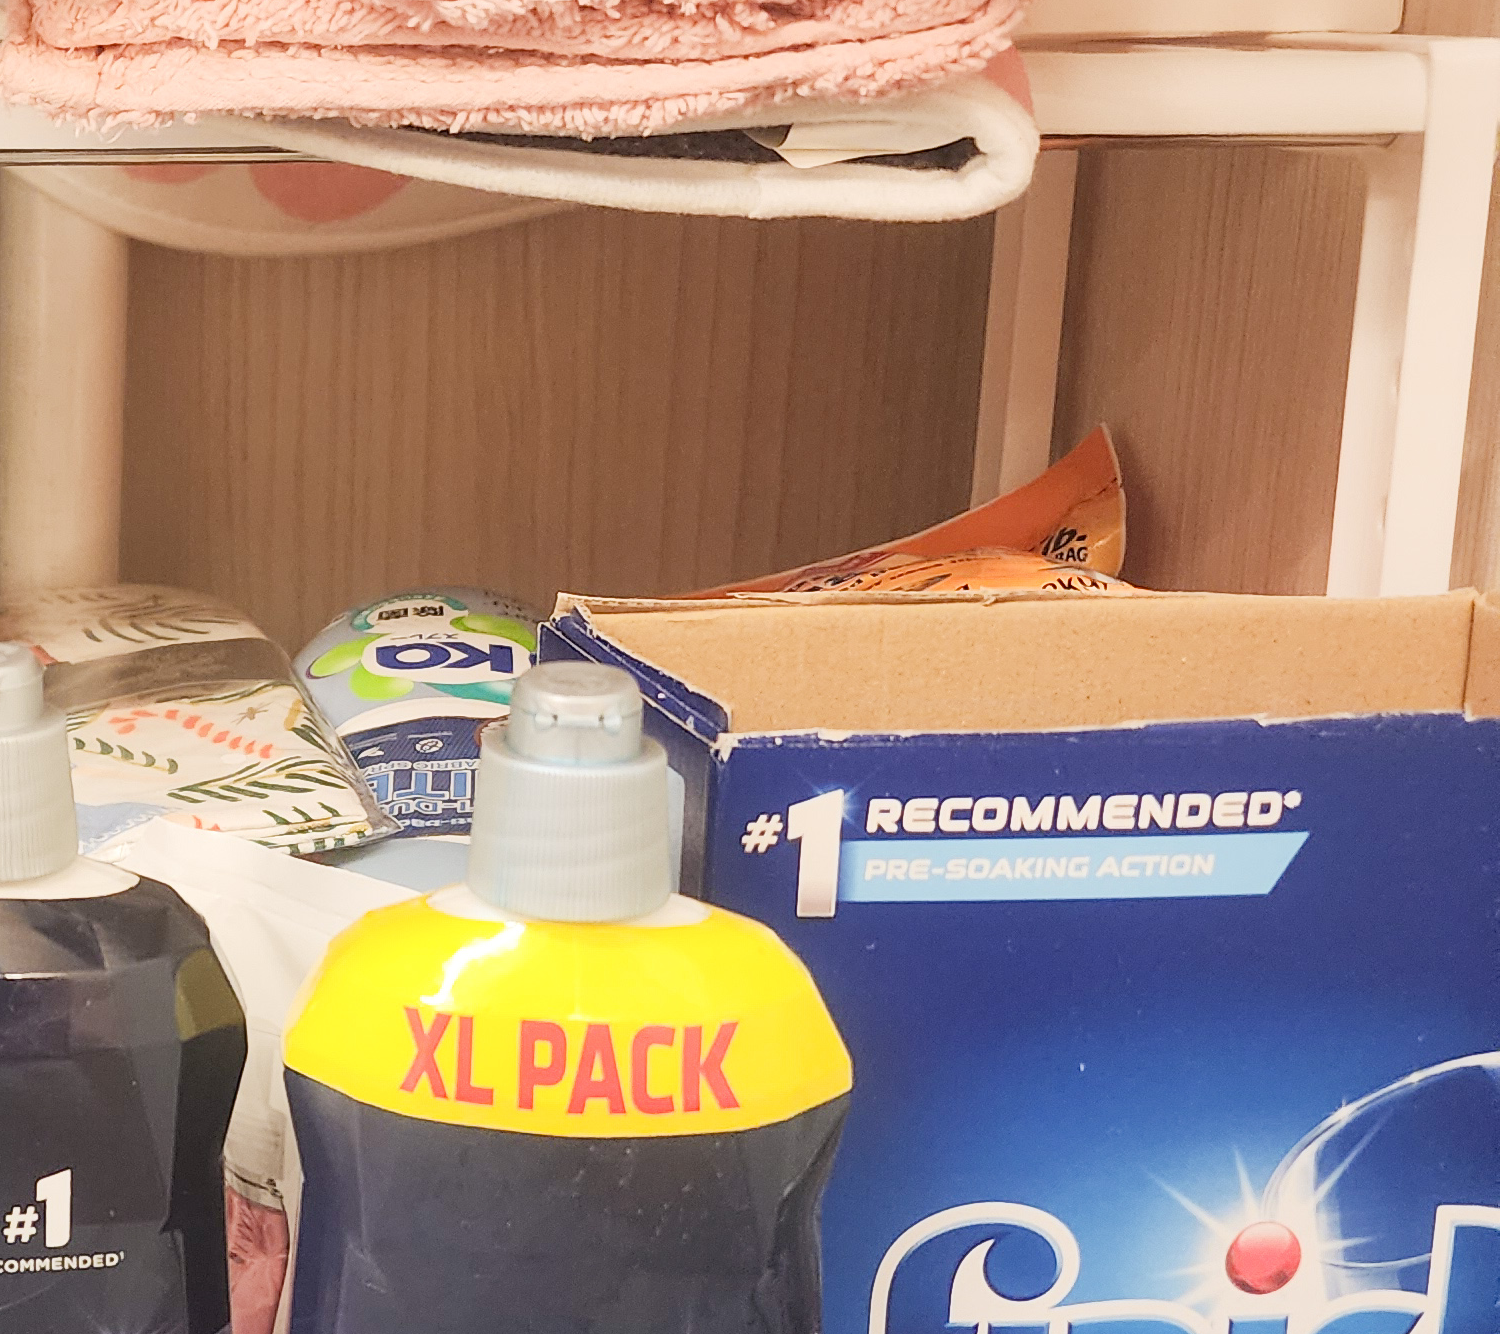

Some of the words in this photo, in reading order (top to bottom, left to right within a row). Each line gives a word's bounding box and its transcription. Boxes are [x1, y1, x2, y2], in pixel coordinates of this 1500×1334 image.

[741, 788, 846, 919] #1
[863, 854, 1090, 883] PRE-SOAKING
[1096, 853, 1216, 880] ACTION
[399, 1004, 495, 1107] XL
[517, 1019, 742, 1116] PACK
[3, 1168, 73, 1249] #1
